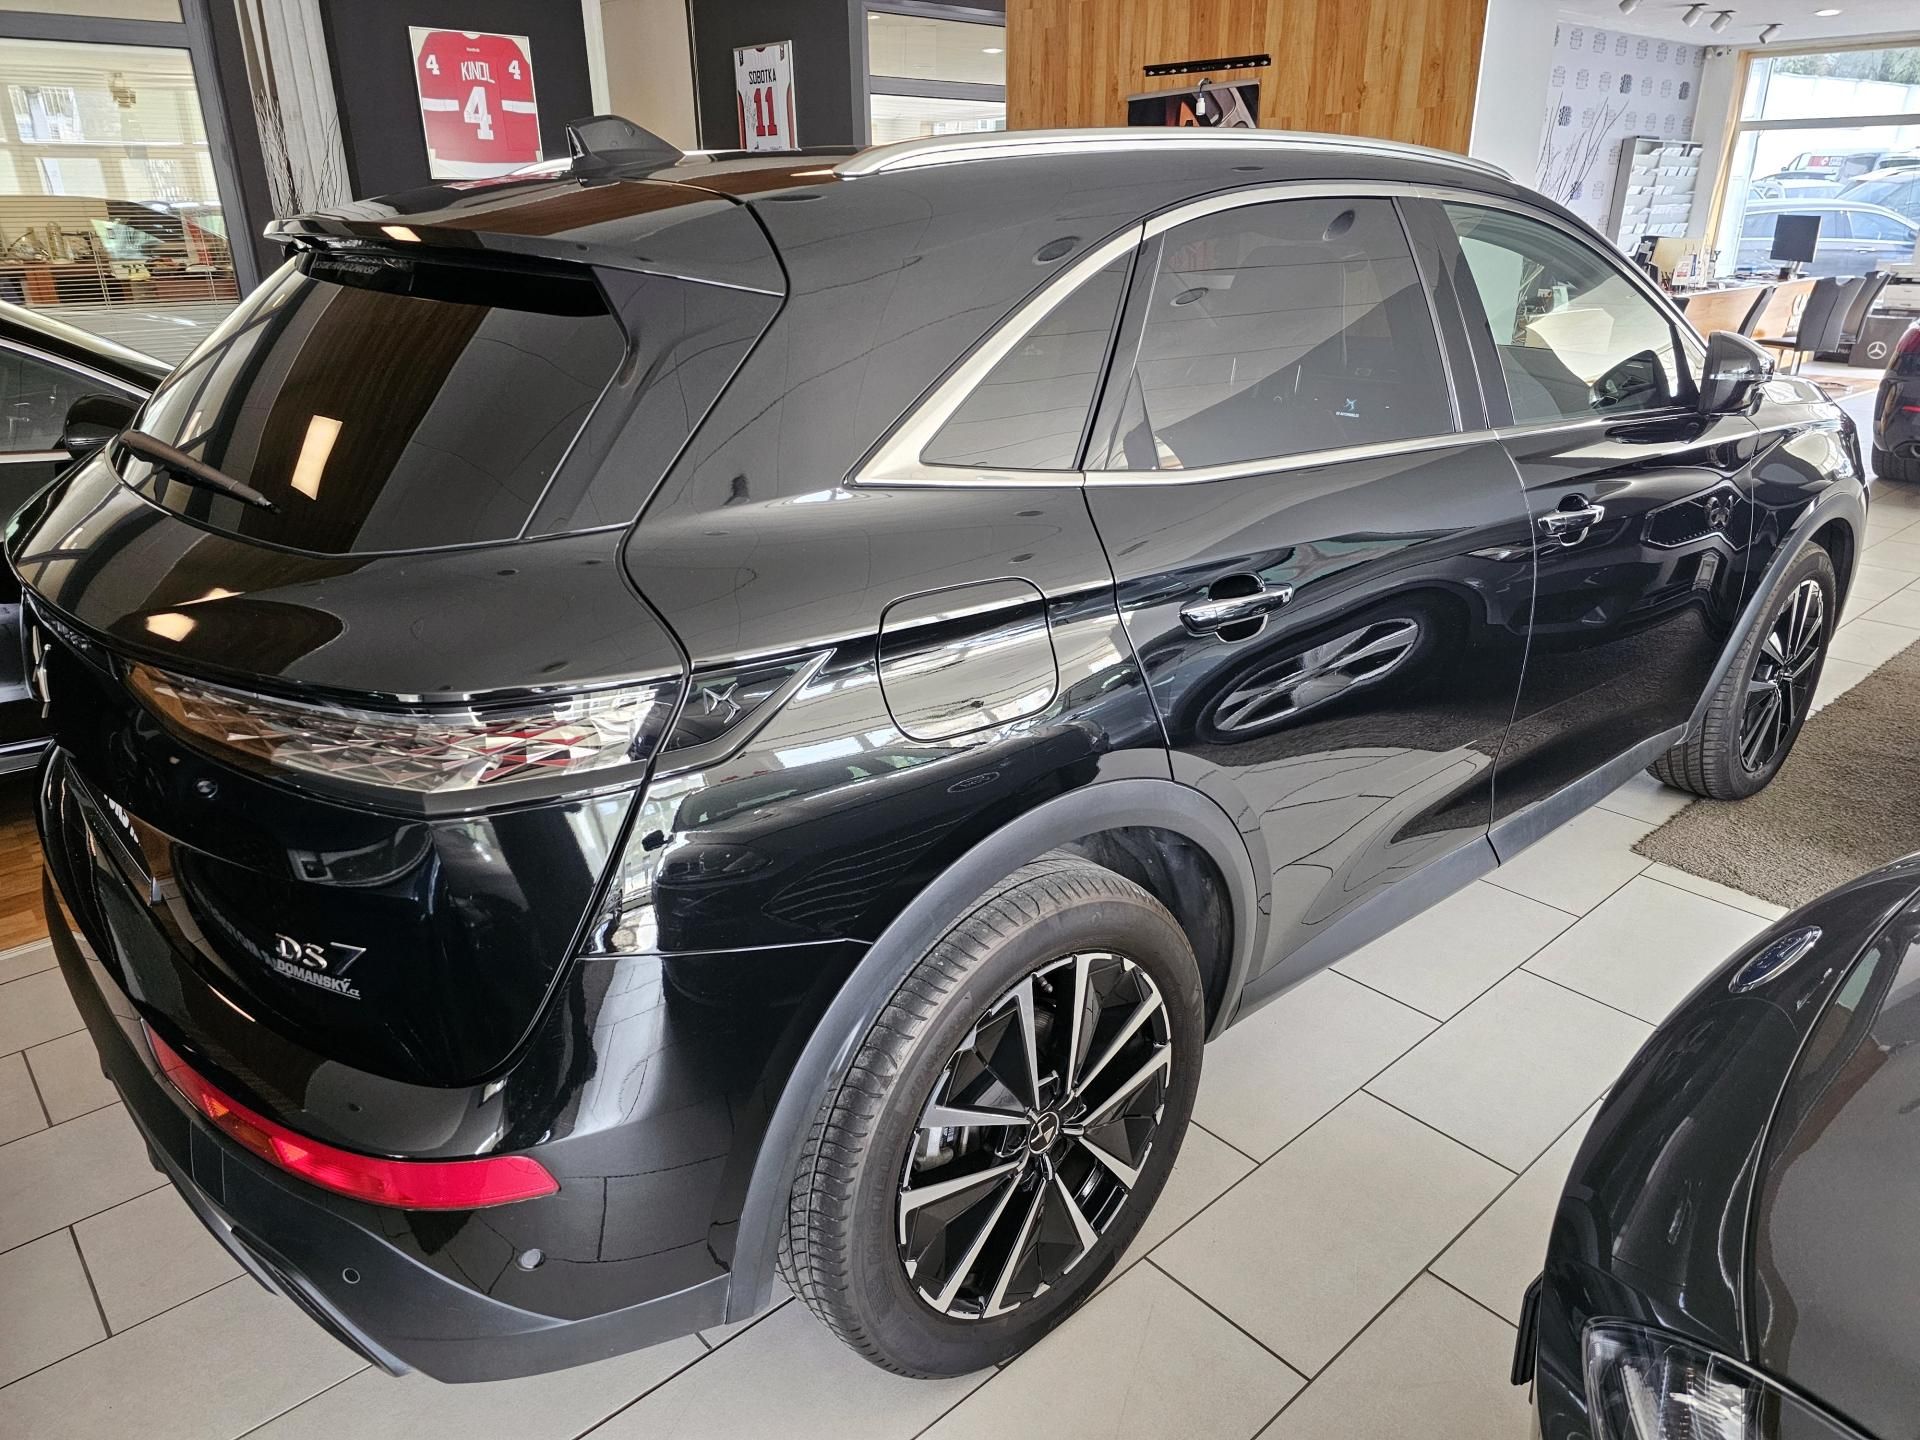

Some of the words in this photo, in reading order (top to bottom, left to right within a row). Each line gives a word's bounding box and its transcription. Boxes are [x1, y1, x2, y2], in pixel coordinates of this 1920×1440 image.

[425, 54, 440, 75] 4
[460, 60, 496, 84] KINDL
[508, 59, 521, 80] 4
[748, 67, 777, 85] SOBOTKA
[463, 86, 494, 140] 4
[753, 86, 778, 137] 11
